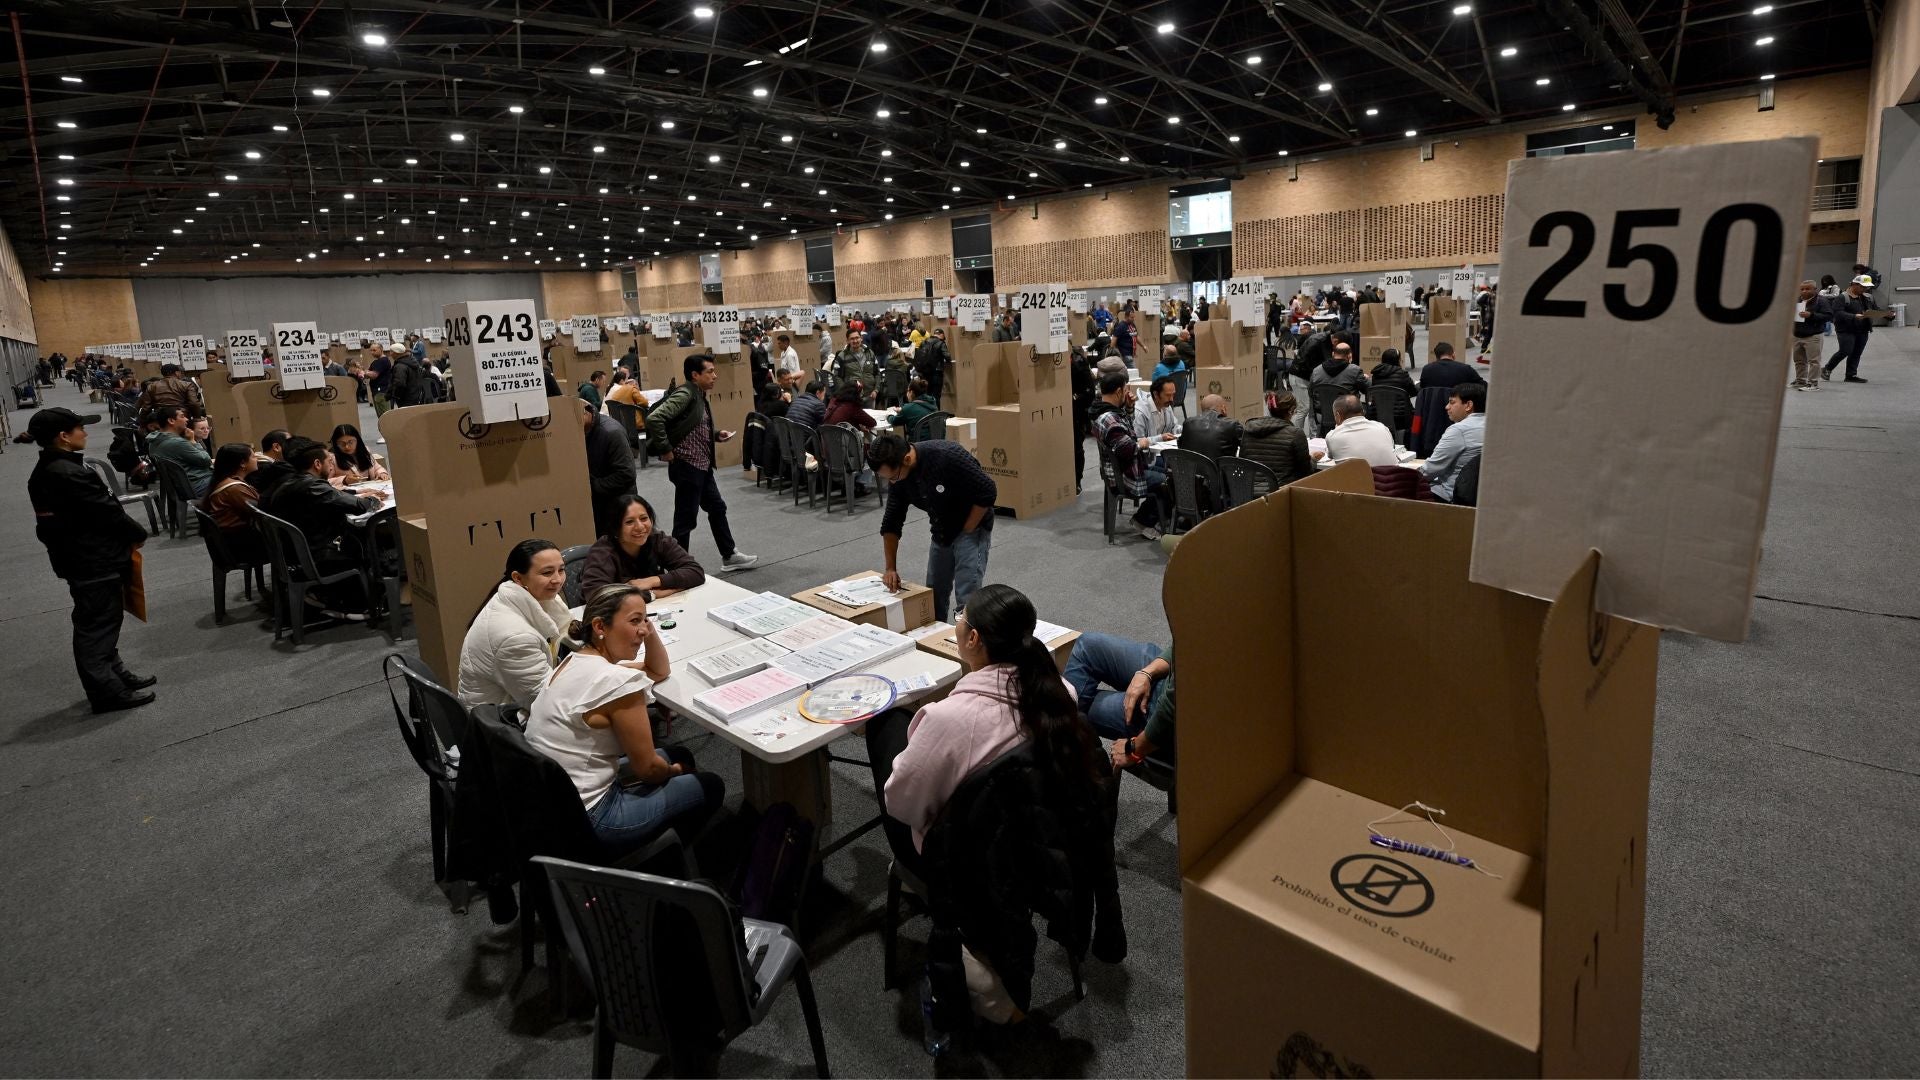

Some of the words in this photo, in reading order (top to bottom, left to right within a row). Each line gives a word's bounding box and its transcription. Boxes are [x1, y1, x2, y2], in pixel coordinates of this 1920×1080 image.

[1172, 238, 1182, 248] 12
[1521, 203, 1783, 324] 250
[1386, 276, 1404, 286] 240
[1231, 282, 1250, 296] 241
[958, 298, 972, 308] 232
[974, 298, 986, 308] 232
[1022, 292, 1046, 309] 242
[1050, 292, 1067, 308] 242
[581, 318, 598, 329] 224
[702, 311, 717, 323] 233
[718, 310, 738, 323] 233
[445, 316, 470, 346] 243
[476, 313, 534, 344] 243
[182, 339, 203, 348] 216
[230, 335, 257, 348] 225
[278, 330, 316, 347] 234
[482, 356, 539, 370] 80.767.145
[485, 377, 542, 392] 80.778.912
[1271, 874, 1335, 908] Prohibido
[1337, 904, 1350, 916] el
[1353, 912, 1378, 930] uso
[1380, 924, 1400, 938] de
[1402, 935, 1456, 964] celular
